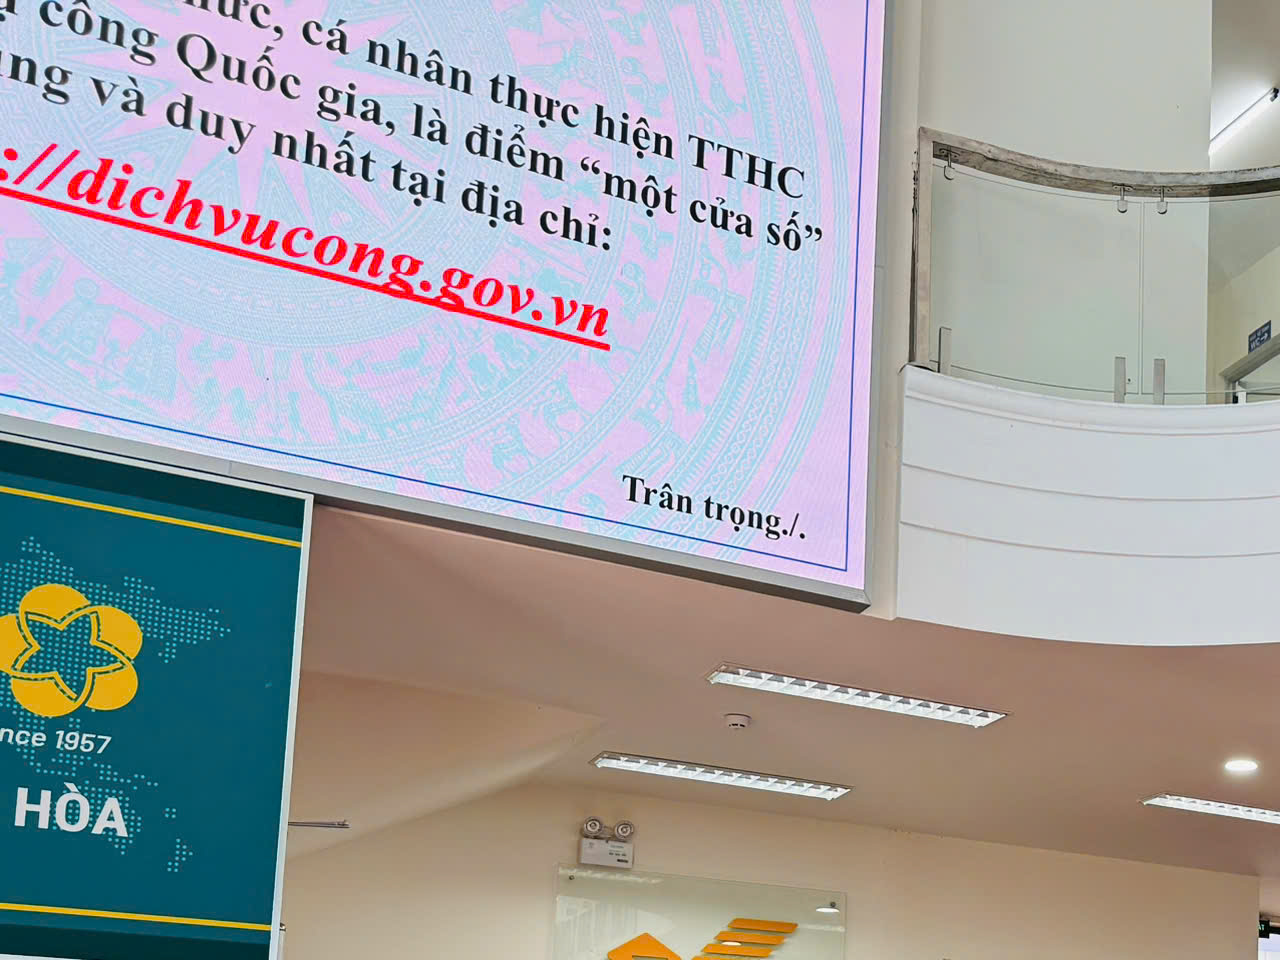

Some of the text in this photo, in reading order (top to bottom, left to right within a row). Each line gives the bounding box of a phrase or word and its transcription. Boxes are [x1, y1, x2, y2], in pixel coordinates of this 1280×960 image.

[0, 51, 612, 251] ng và duy nhất tại địa chỉ:
[39, 0, 160, 66] công
[176, 33, 301, 100] Quốc
[316, 83, 397, 137] gia,
[411, 103, 449, 145] là
[465, 123, 565, 181] điểm
[580, 156, 678, 217] “một
[689, 197, 753, 238] cửa
[302, 20, 349, 55] cá
[366, 39, 473, 96] nhân
[489, 74, 580, 129] thực
[594, 104, 674, 159] hiện
[688, 134, 805, 199] TTHC
[622, 474, 806, 541] Trân trọng./.
[0, 727, 112, 754] nce 1957
[14, 782, 128, 837] HÒA
